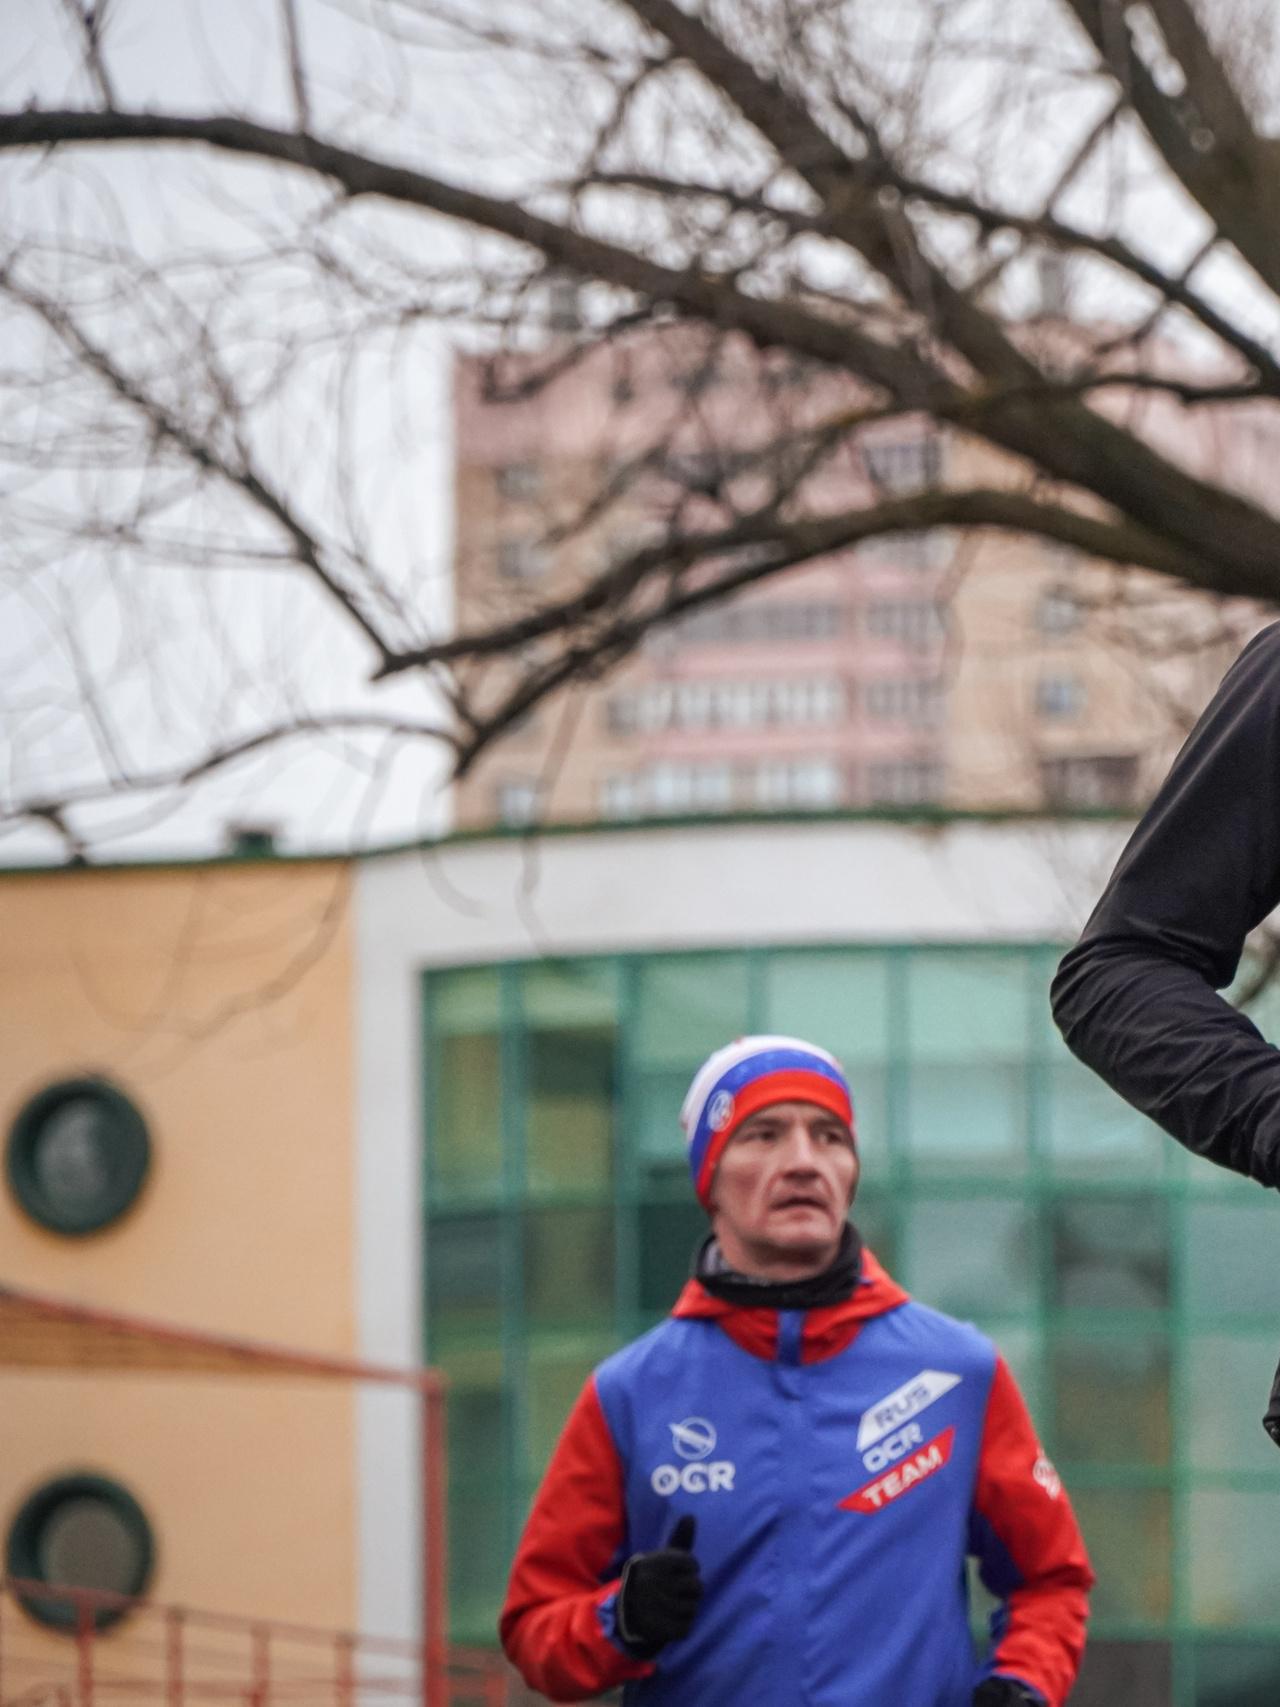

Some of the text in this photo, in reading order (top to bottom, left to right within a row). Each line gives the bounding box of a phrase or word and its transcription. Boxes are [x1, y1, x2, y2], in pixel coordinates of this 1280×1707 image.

[873, 1384, 931, 1428] RUS
[862, 1421, 924, 1473] OCR
[650, 1460, 736, 1497] OCR
[861, 1444, 943, 1507] TEAM
